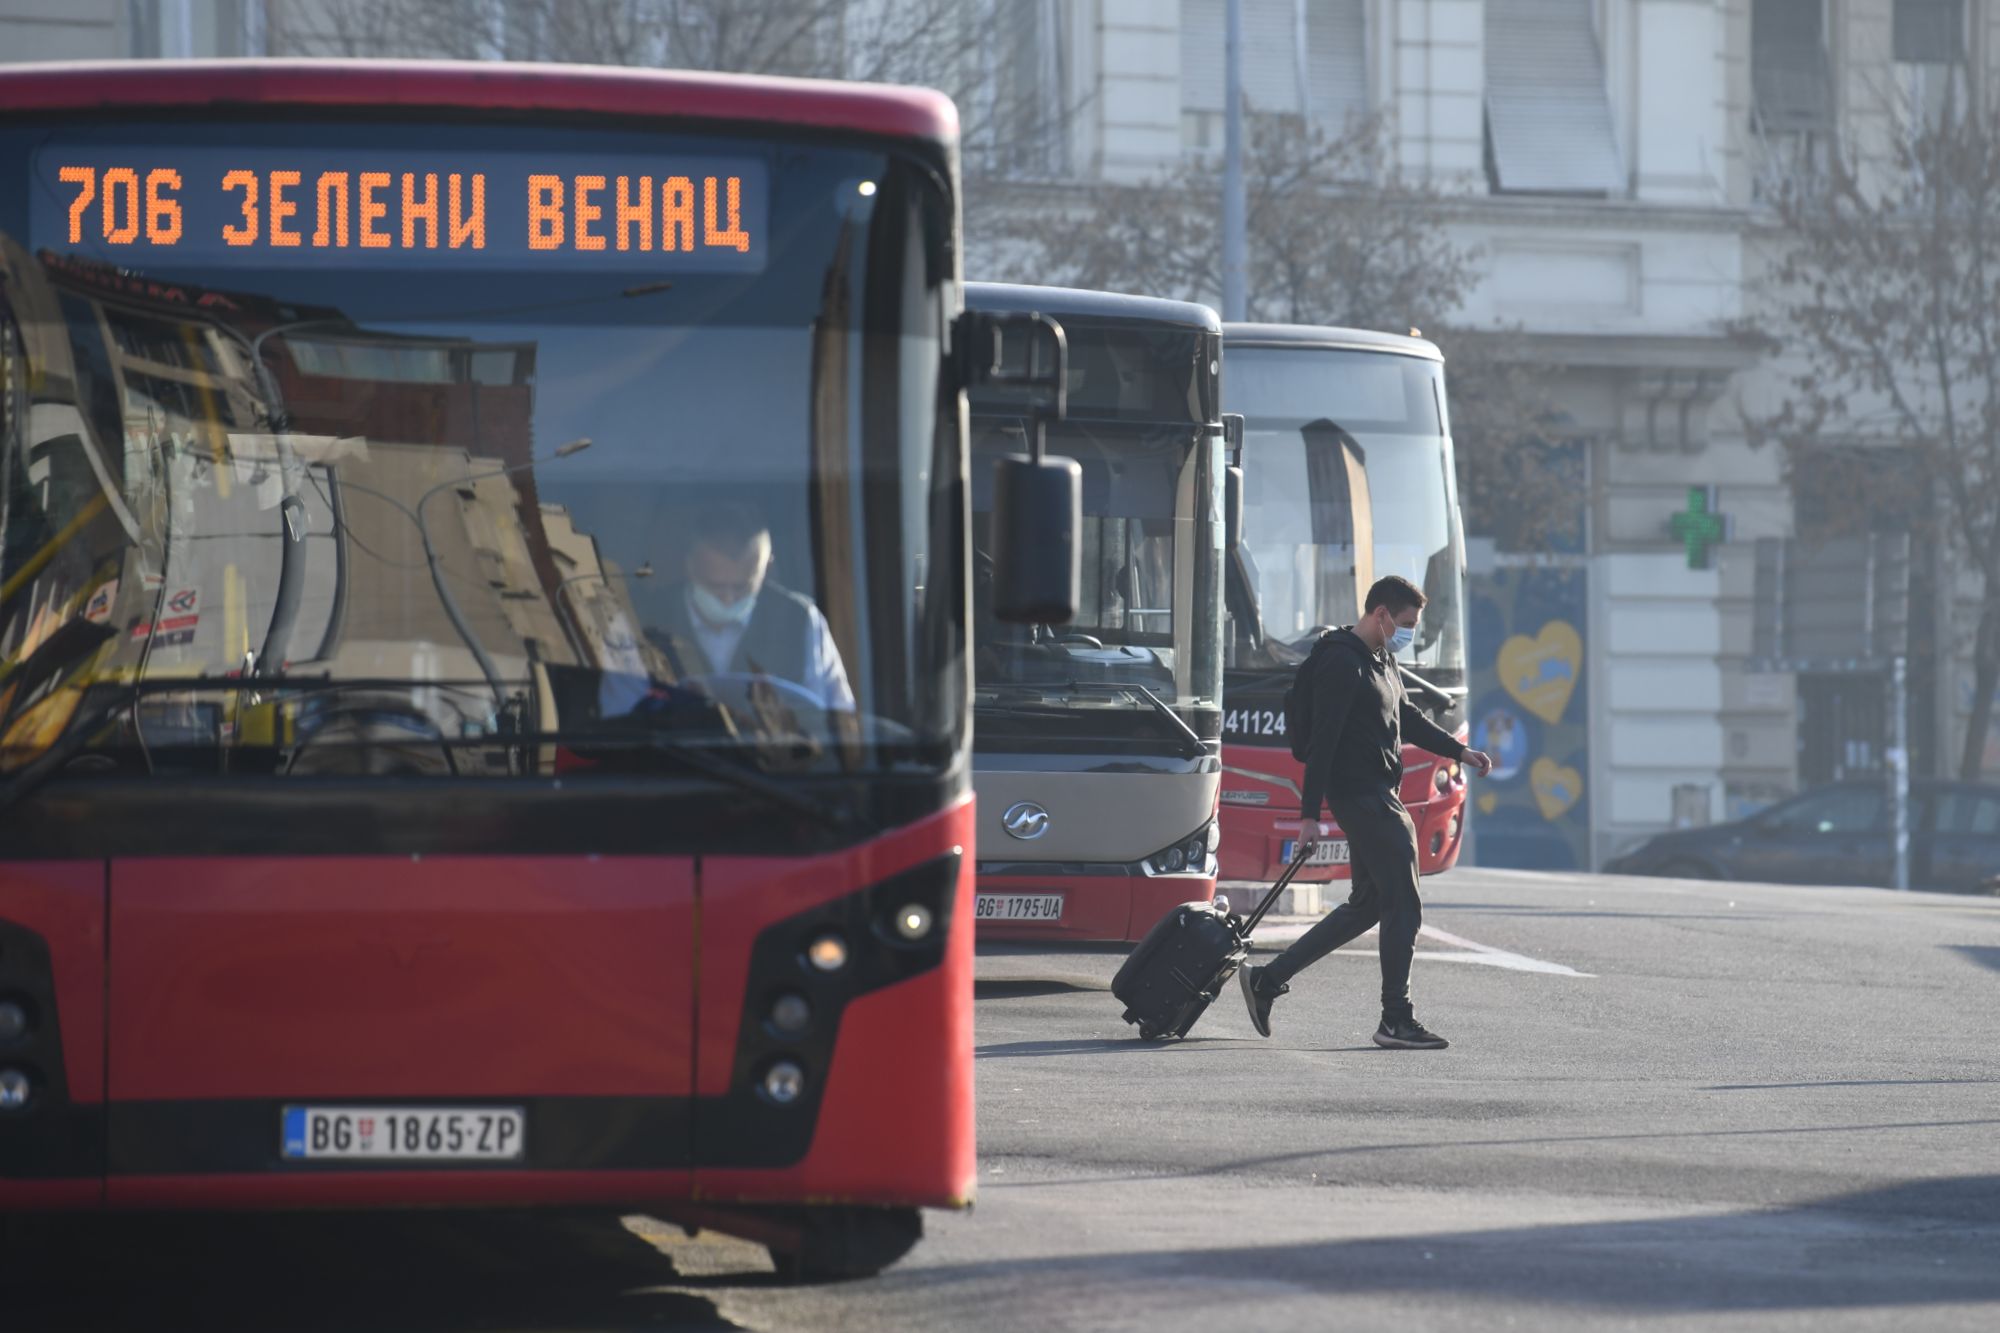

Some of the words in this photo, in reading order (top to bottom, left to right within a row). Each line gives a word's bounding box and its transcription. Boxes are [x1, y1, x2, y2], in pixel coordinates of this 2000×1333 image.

[60, 168, 181, 244] 706
[223, 171, 484, 248] ЗЕЛЕНИ
[529, 176, 748, 251] ВЕНАЦ
[976, 898, 996, 917] BG
[312, 1115, 351, 1152] BG
